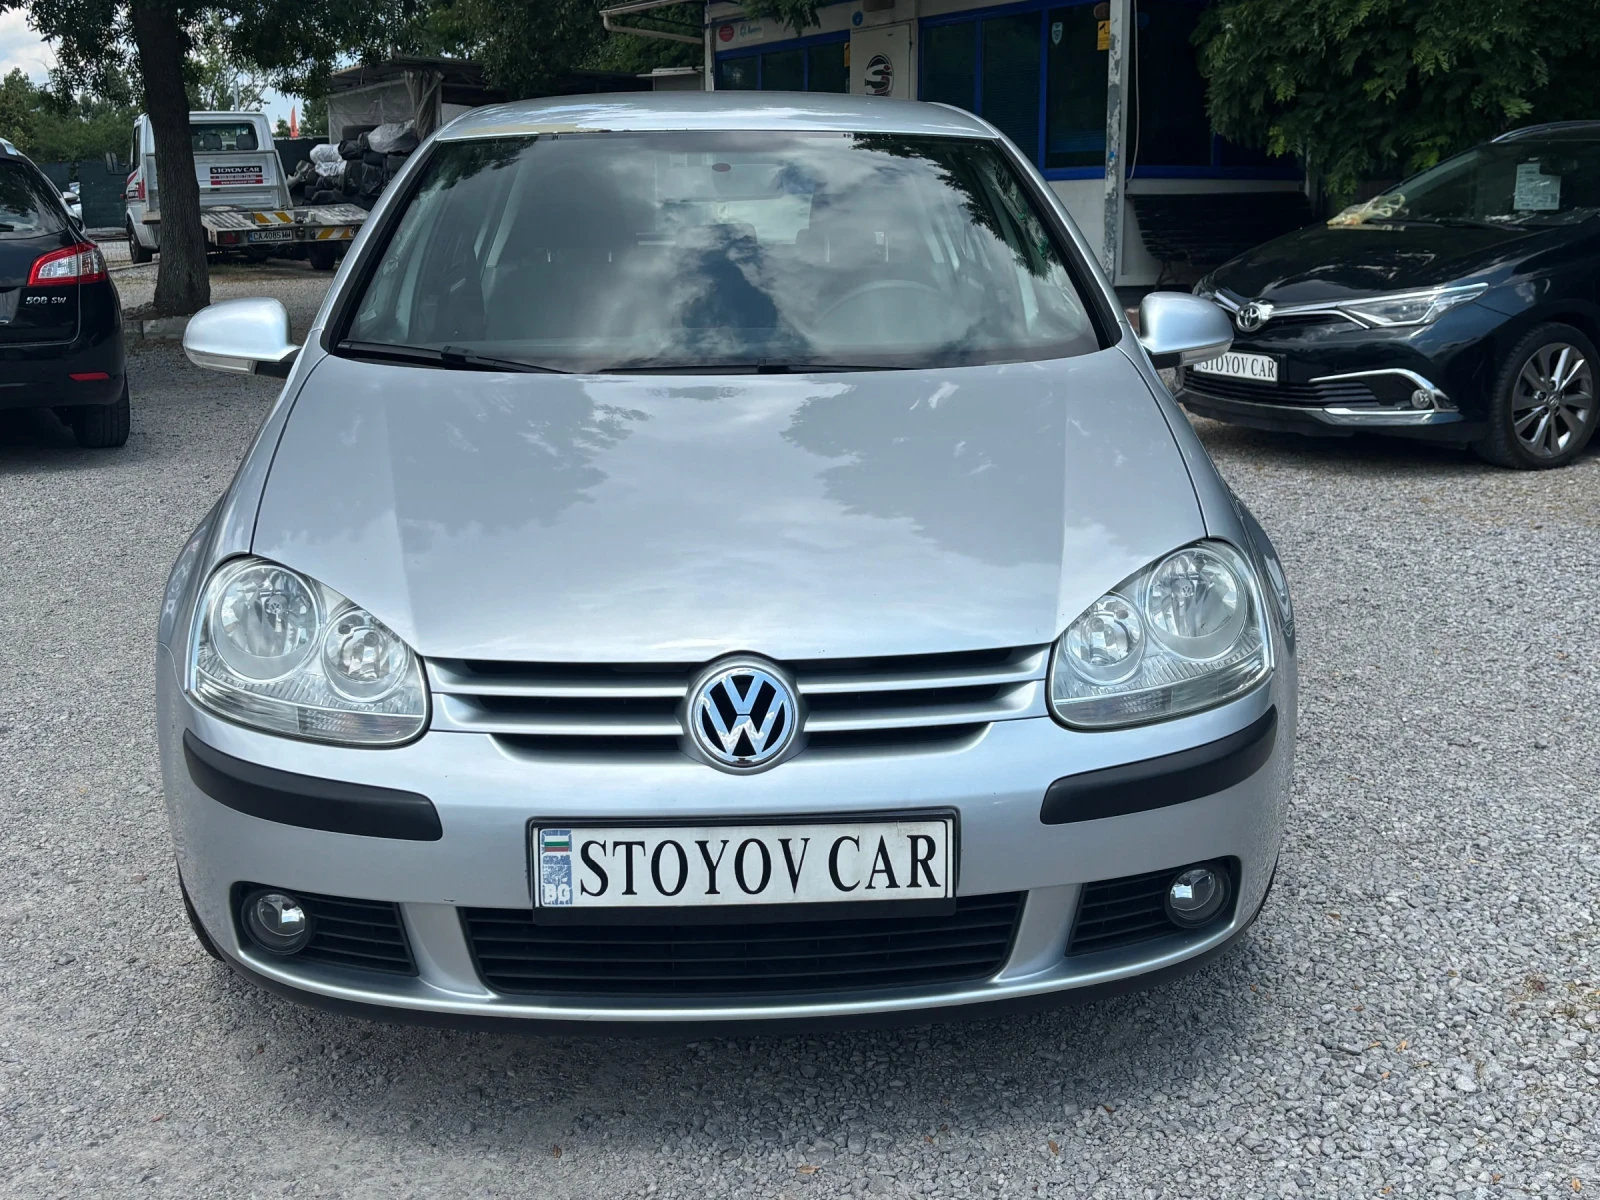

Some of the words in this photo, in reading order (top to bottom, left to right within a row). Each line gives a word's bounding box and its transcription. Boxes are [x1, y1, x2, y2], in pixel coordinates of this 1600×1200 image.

[26, 296, 48, 304] 508
[51, 296, 67, 304] SW
[1251, 358, 1275, 378] CAR
[693, 666, 794, 768] VW
[579, 837, 812, 897] STOYOV
[828, 834, 942, 893] CAR
[544, 883, 571, 905] BG
